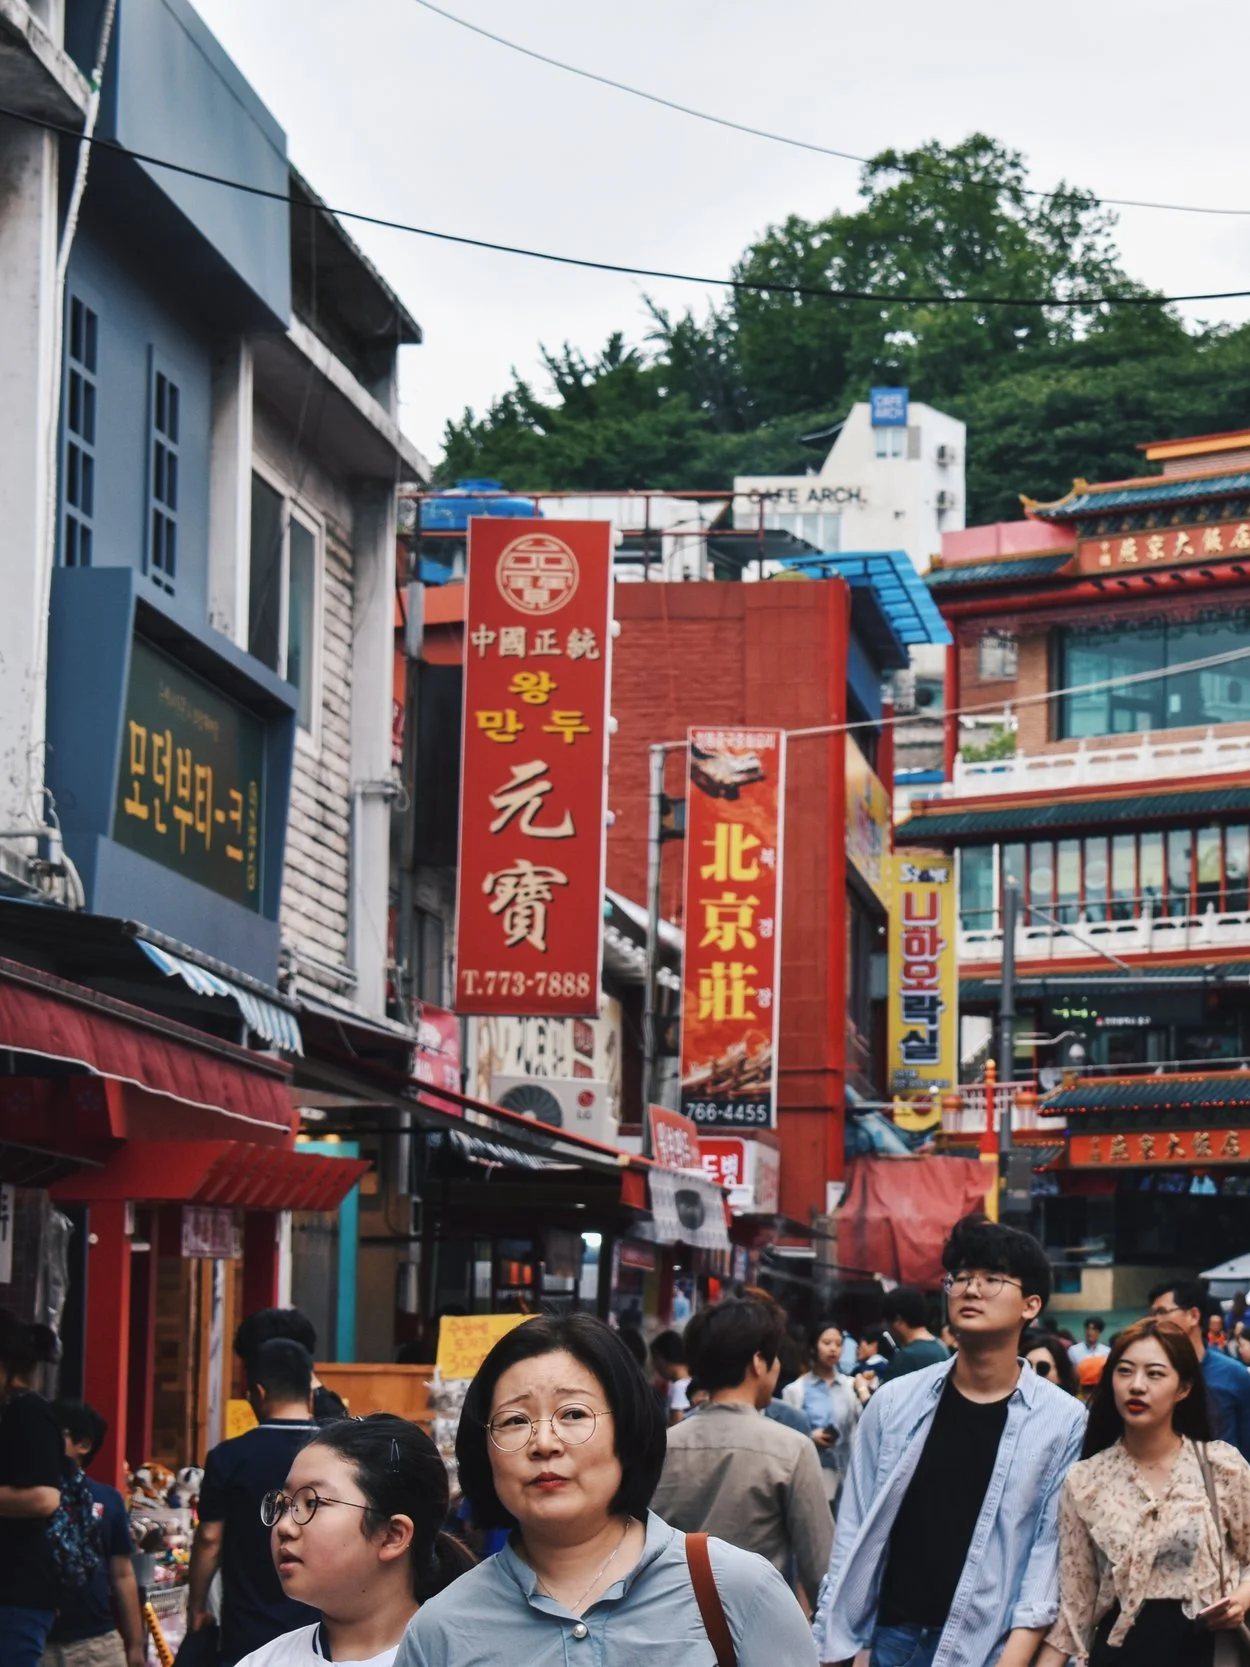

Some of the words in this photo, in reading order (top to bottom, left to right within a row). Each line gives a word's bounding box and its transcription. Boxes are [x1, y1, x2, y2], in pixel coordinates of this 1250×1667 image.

[749, 487, 799, 504] CAFE
[469, 623, 601, 661] 中國正統
[508, 671, 557, 706] 왕
[475, 708, 592, 745] 만두
[481, 758, 577, 953] 元寶
[698, 822, 762, 1022] 北京莊
[461, 967, 591, 997] T.773-7888
[685, 1102, 767, 1123] 766-4455
